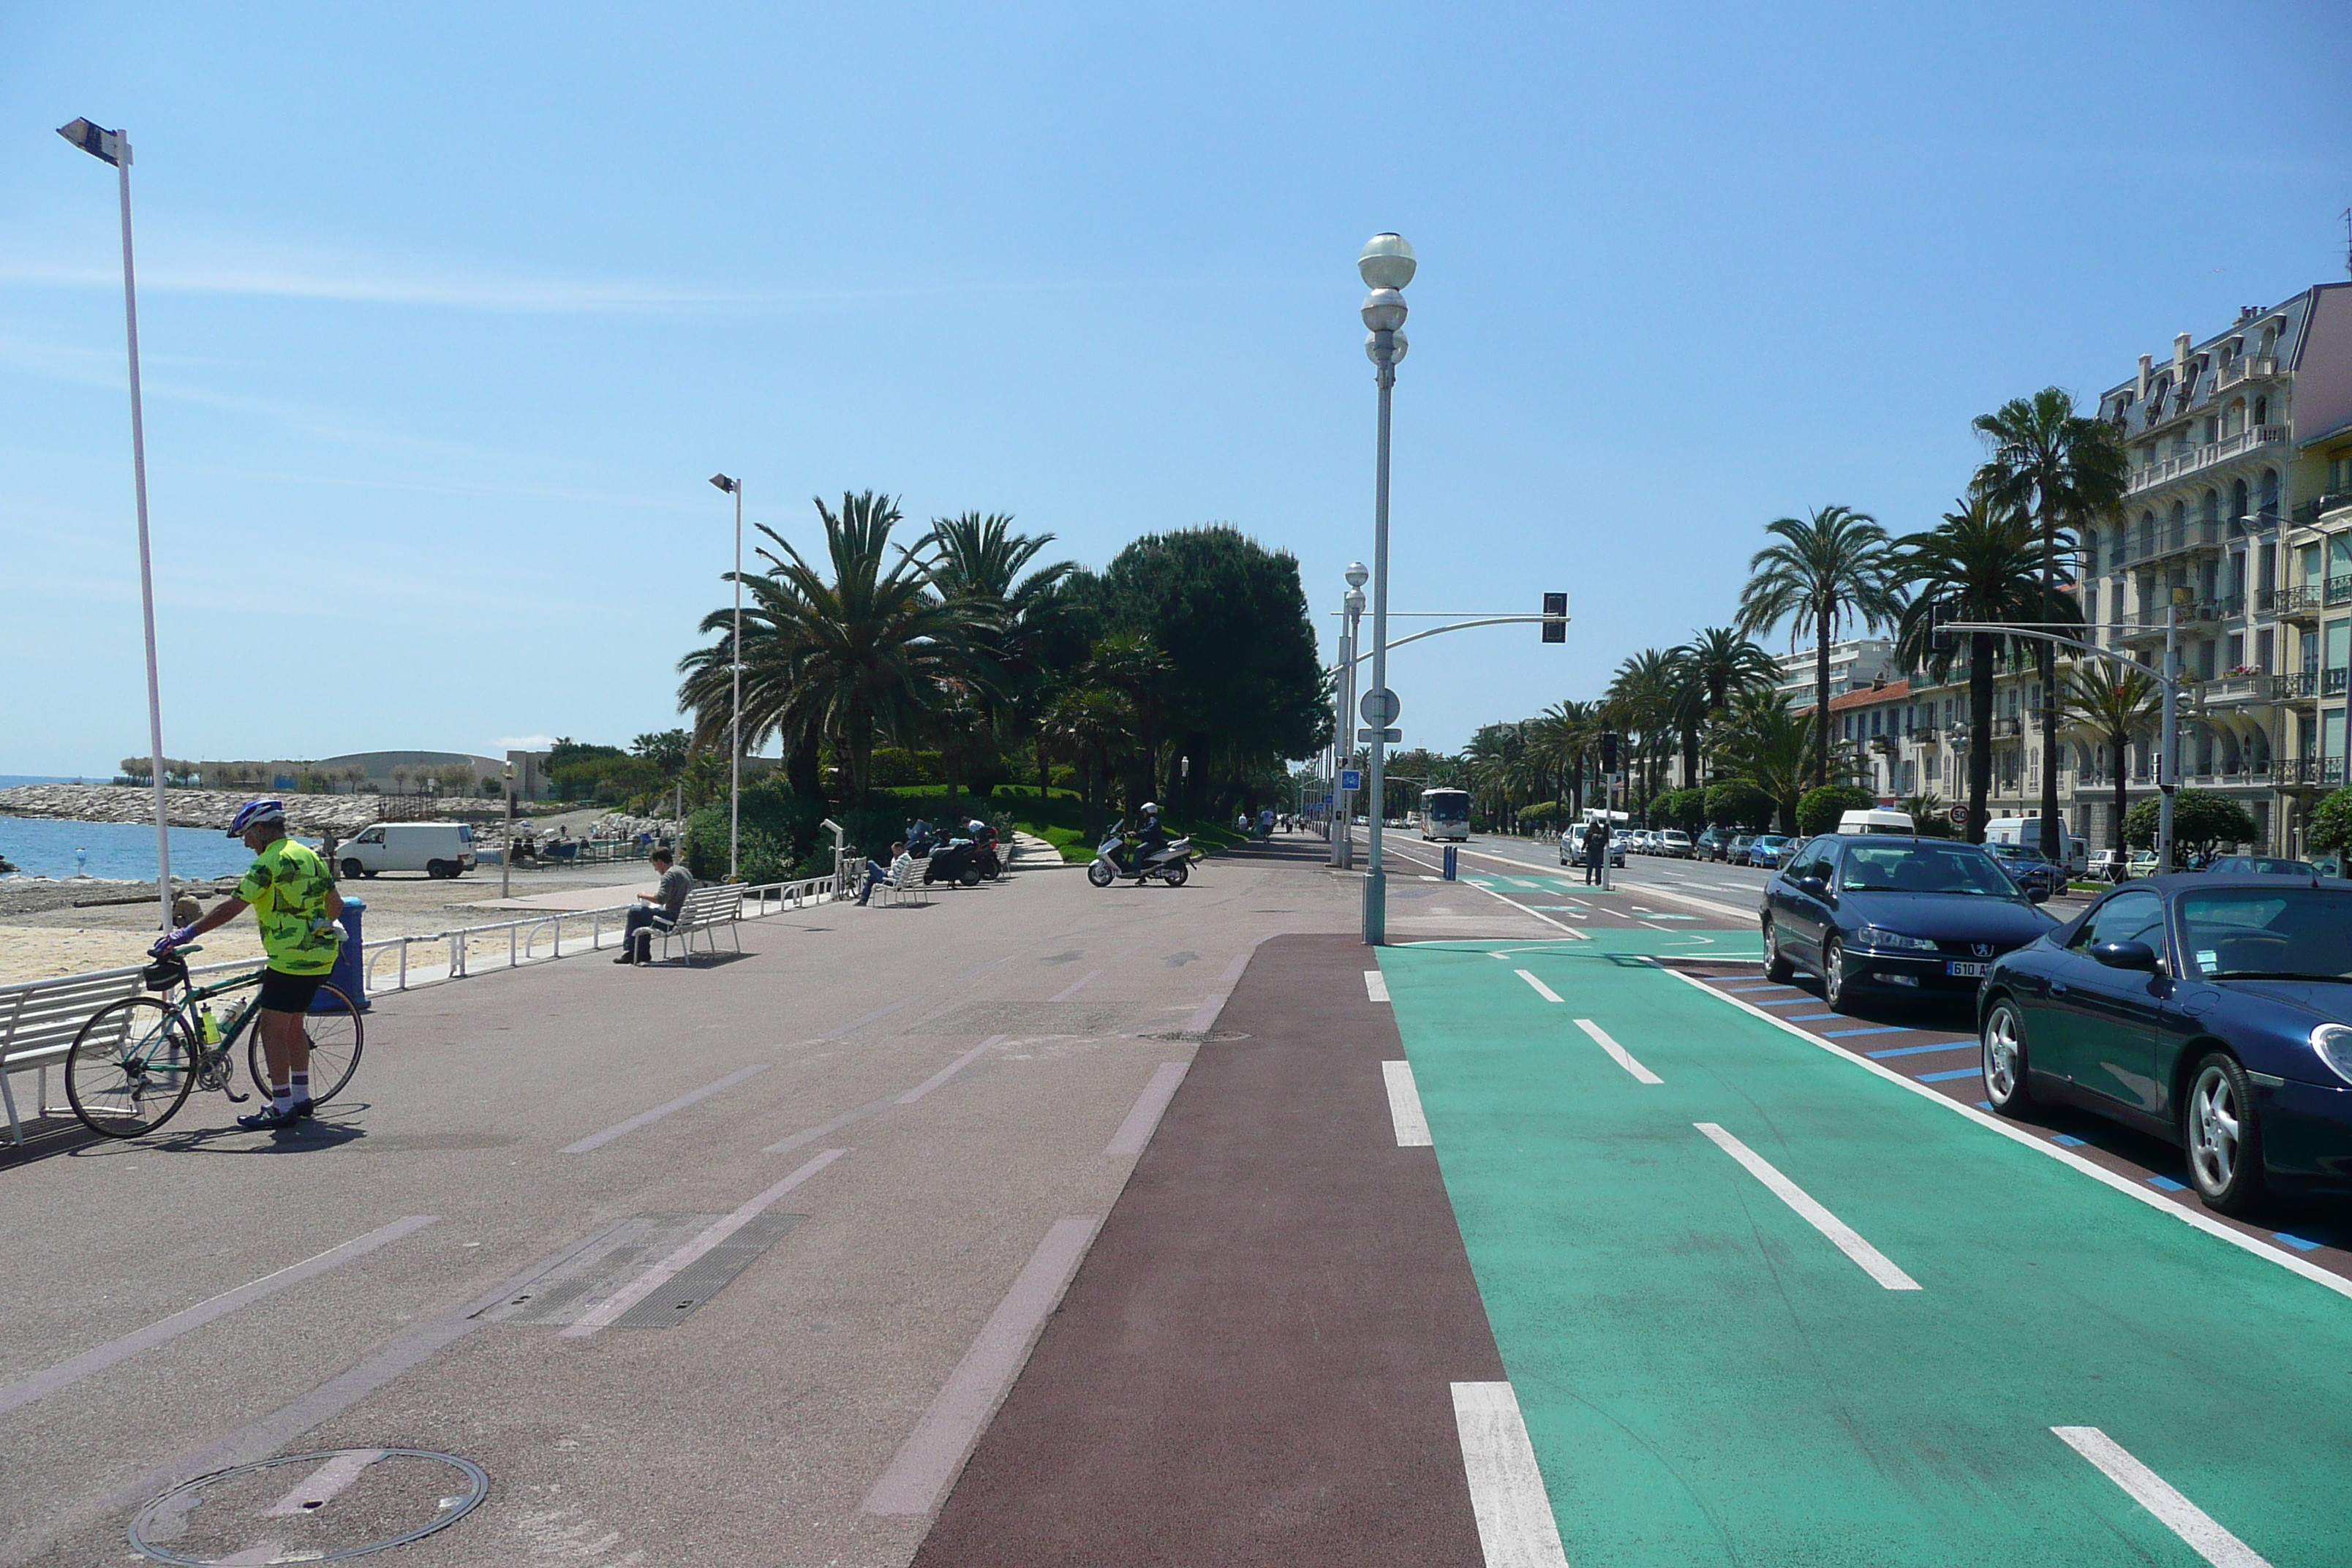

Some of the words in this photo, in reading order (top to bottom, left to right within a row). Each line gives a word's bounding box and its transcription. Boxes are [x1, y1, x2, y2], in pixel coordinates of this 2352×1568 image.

[1954, 810, 1966, 818] 50
[1954, 963, 1975, 975] 610
[1979, 965, 1987, 976] A
